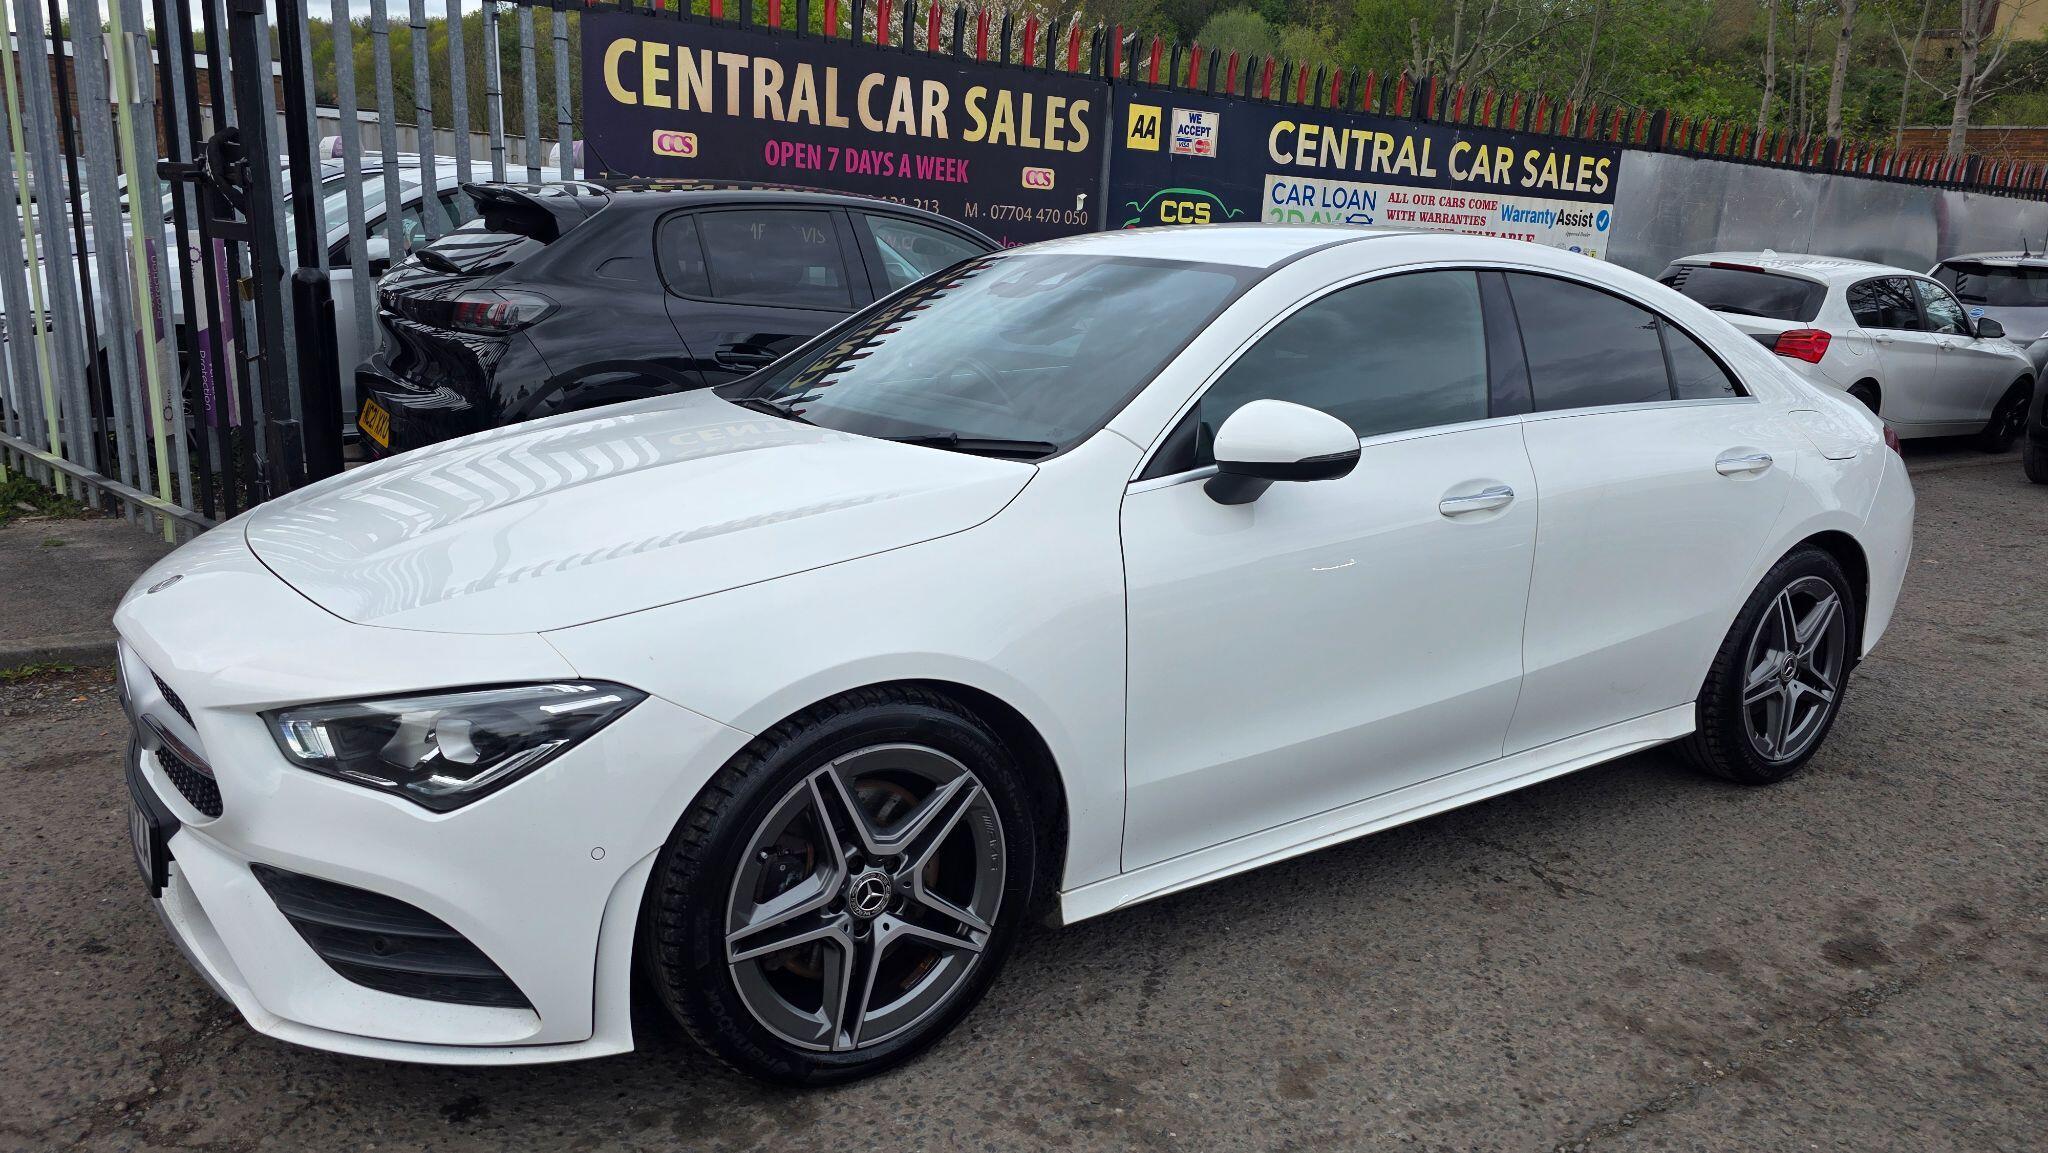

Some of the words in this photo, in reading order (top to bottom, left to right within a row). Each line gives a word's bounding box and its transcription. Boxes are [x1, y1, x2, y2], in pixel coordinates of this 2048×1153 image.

[603, 37, 849, 128] CENTRAL
[857, 72, 950, 139] CAR
[963, 85, 1090, 153] SALES
[1131, 114, 1156, 139] AA
[1189, 112, 1202, 124] WE
[1178, 124, 1211, 137] ACCEPT
[764, 139, 821, 170] OPEN
[827, 147, 839, 171] 7
[845, 148, 894, 177] DAYS
[898, 154, 911, 178] A
[916, 154, 969, 183] WEEK
[1268, 120, 1437, 178] CENTRAL
[1448, 141, 1515, 185] CAR
[1520, 150, 1612, 194] SALES
[1271, 182, 1316, 206] CAR
[1321, 186, 1377, 211] LOAN
[1387, 192, 1409, 204] ALL
[1412, 194, 1436, 206] OUR
[1439, 196, 1465, 209] CARS
[1468, 198, 1498, 211] COME
[990, 204, 1032, 222] 07704
[1036, 208, 1061, 224] 470
[1064, 210, 1088, 226] 050
[1160, 200, 1211, 224] CCS
[1387, 209, 1416, 221] WITH
[1420, 211, 1487, 227] WARRANTIES
